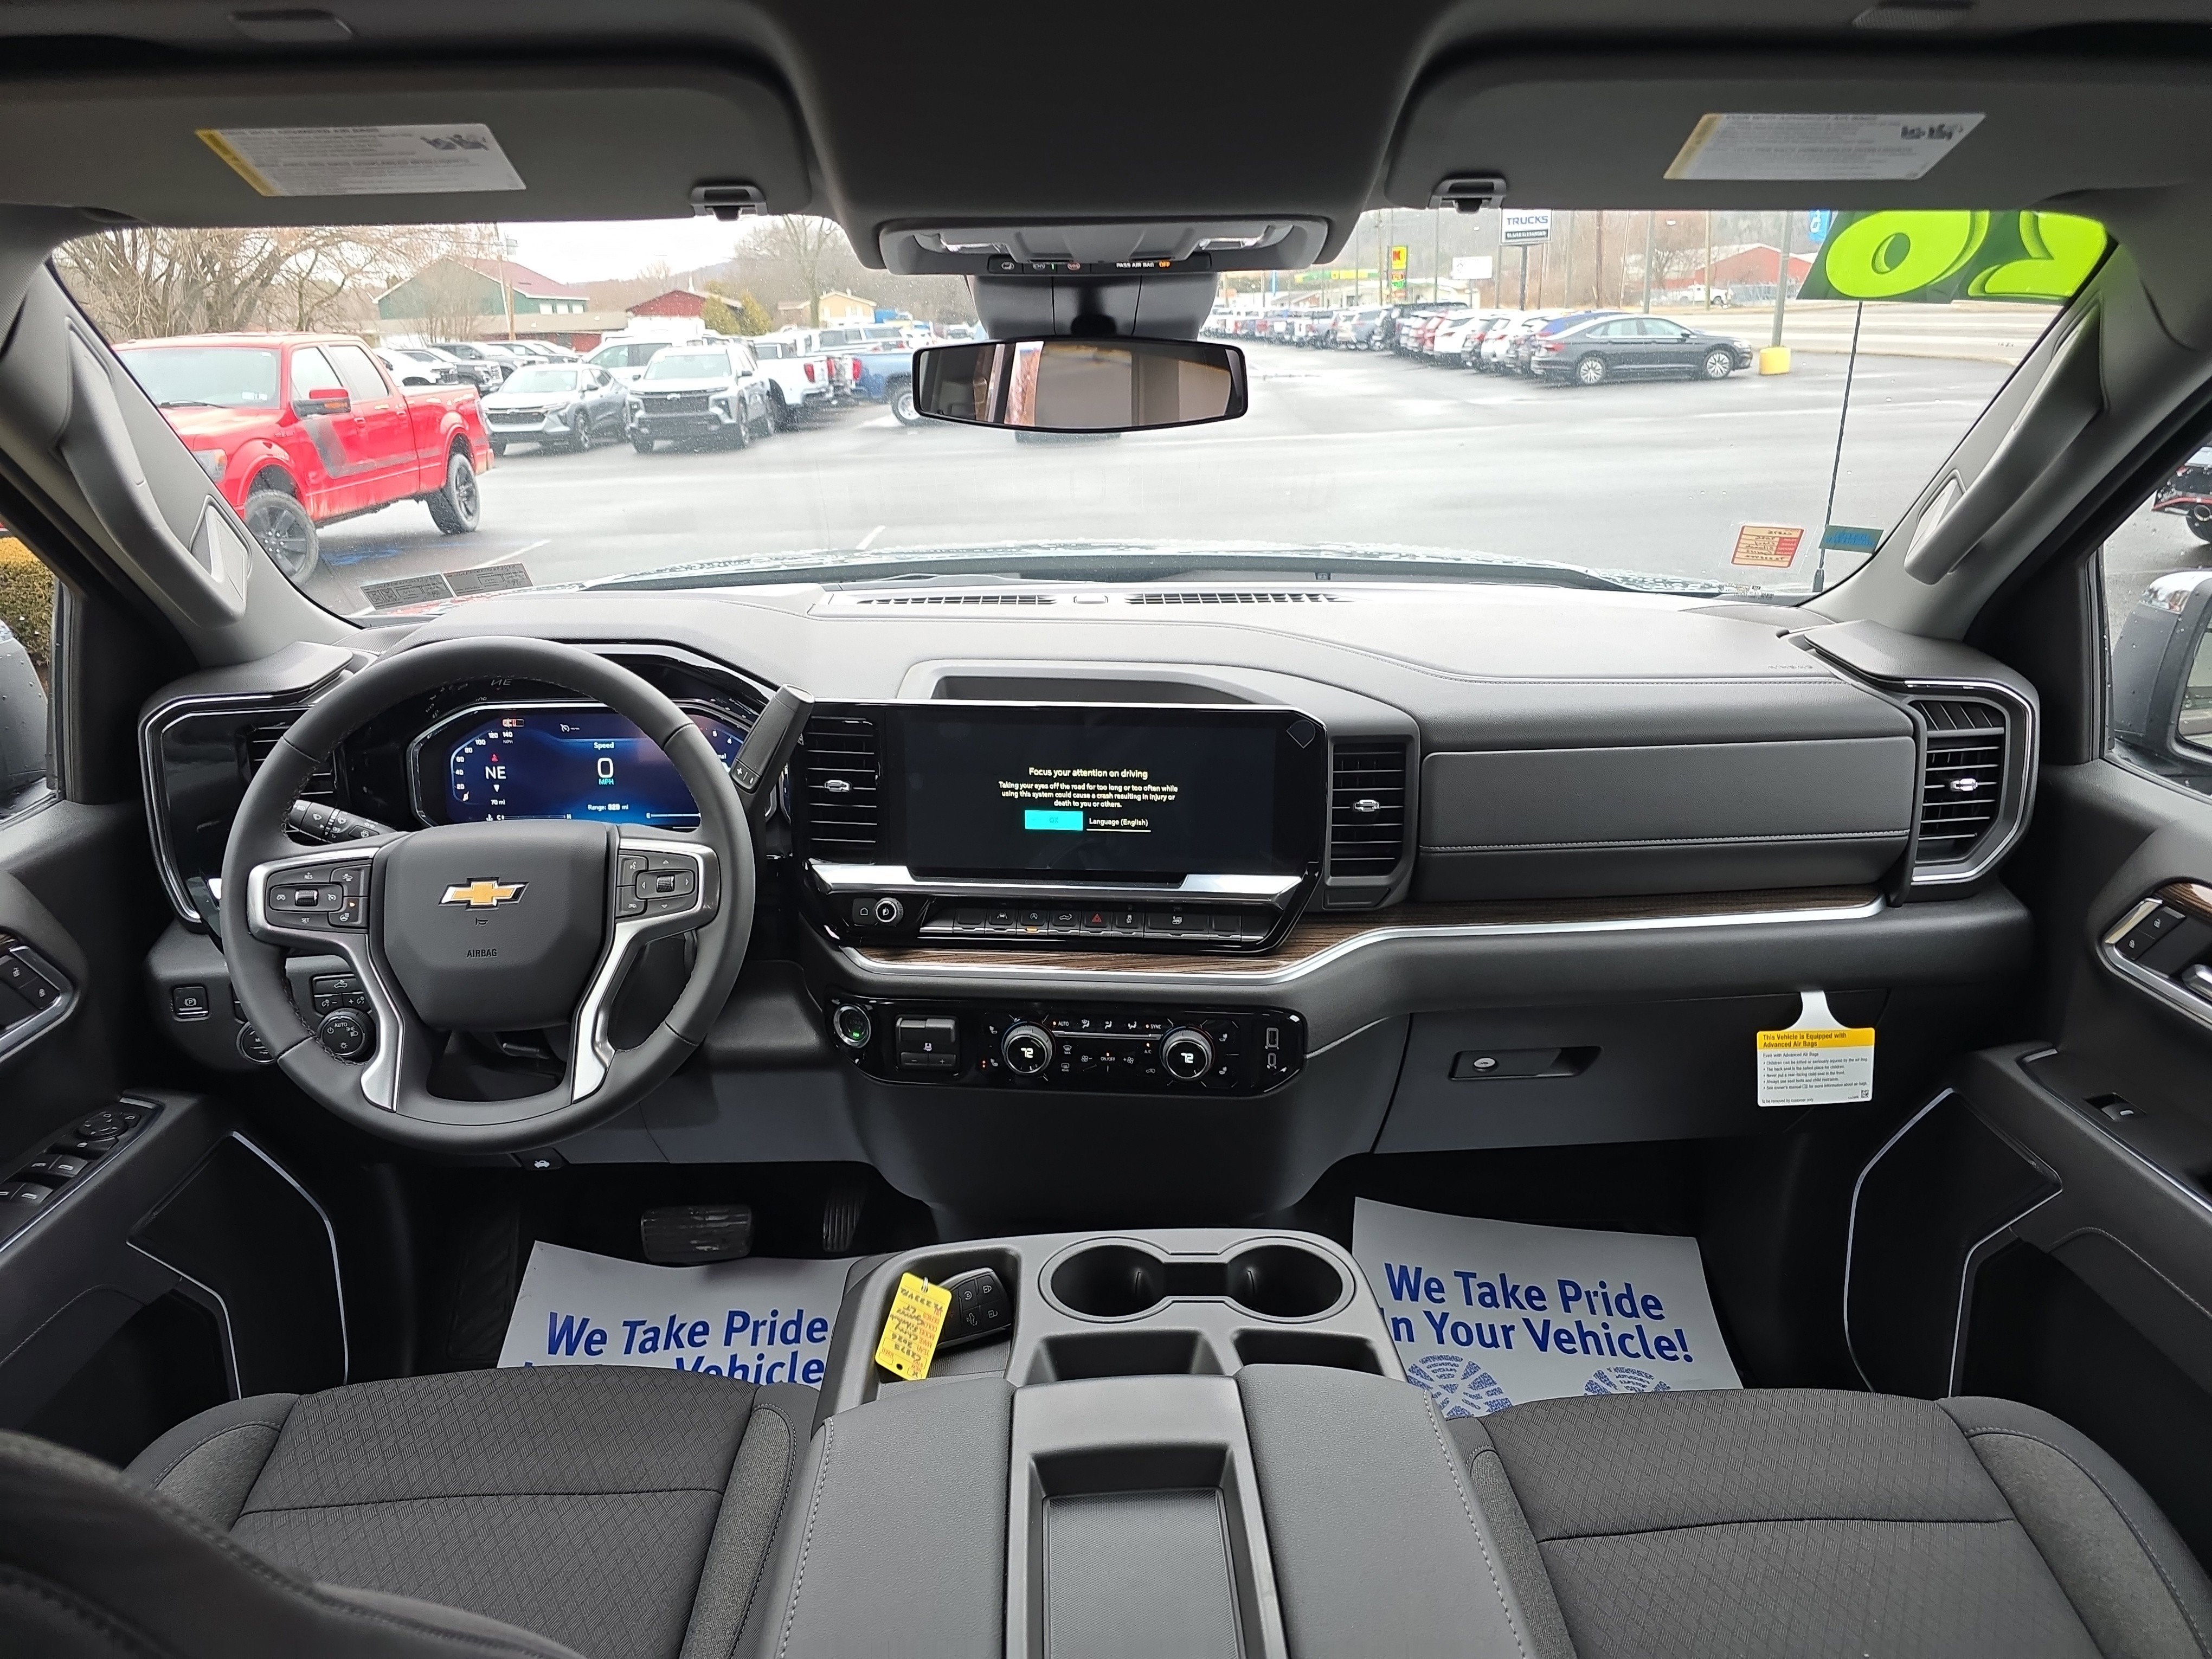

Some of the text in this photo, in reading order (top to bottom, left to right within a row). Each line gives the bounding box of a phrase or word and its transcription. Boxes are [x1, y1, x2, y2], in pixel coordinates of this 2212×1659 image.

[1507, 216, 1548, 225] TRUCKS
[594, 742, 614, 750] Speed
[485, 766, 506, 779] NE
[597, 757, 614, 778] 0
[1028, 767, 1052, 776] Focus
[1053, 770, 1071, 778] your
[1072, 769, 1107, 777] attention
[1121, 769, 1148, 780] driving
[998, 781, 1019, 790] Taking
[1109, 783, 1122, 792] long
[1002, 790, 1019, 799] using
[1114, 793, 1141, 801] resulting
[1149, 794, 1167, 802] injury
[1089, 818, 1119, 826] Language
[1121, 818, 1148, 827] (English)
[467, 949, 497, 957] AIRBAG
[1020, 1048, 1033, 1058] 72
[1181, 1053, 1193, 1064] 72
[1384, 1262, 1666, 1321] We Take Pride
[548, 1308, 828, 1356] We Take Pride
[1379, 1307, 1694, 1363] n Your Vehicle!
[917, 1345, 929, 1356] YEAR
